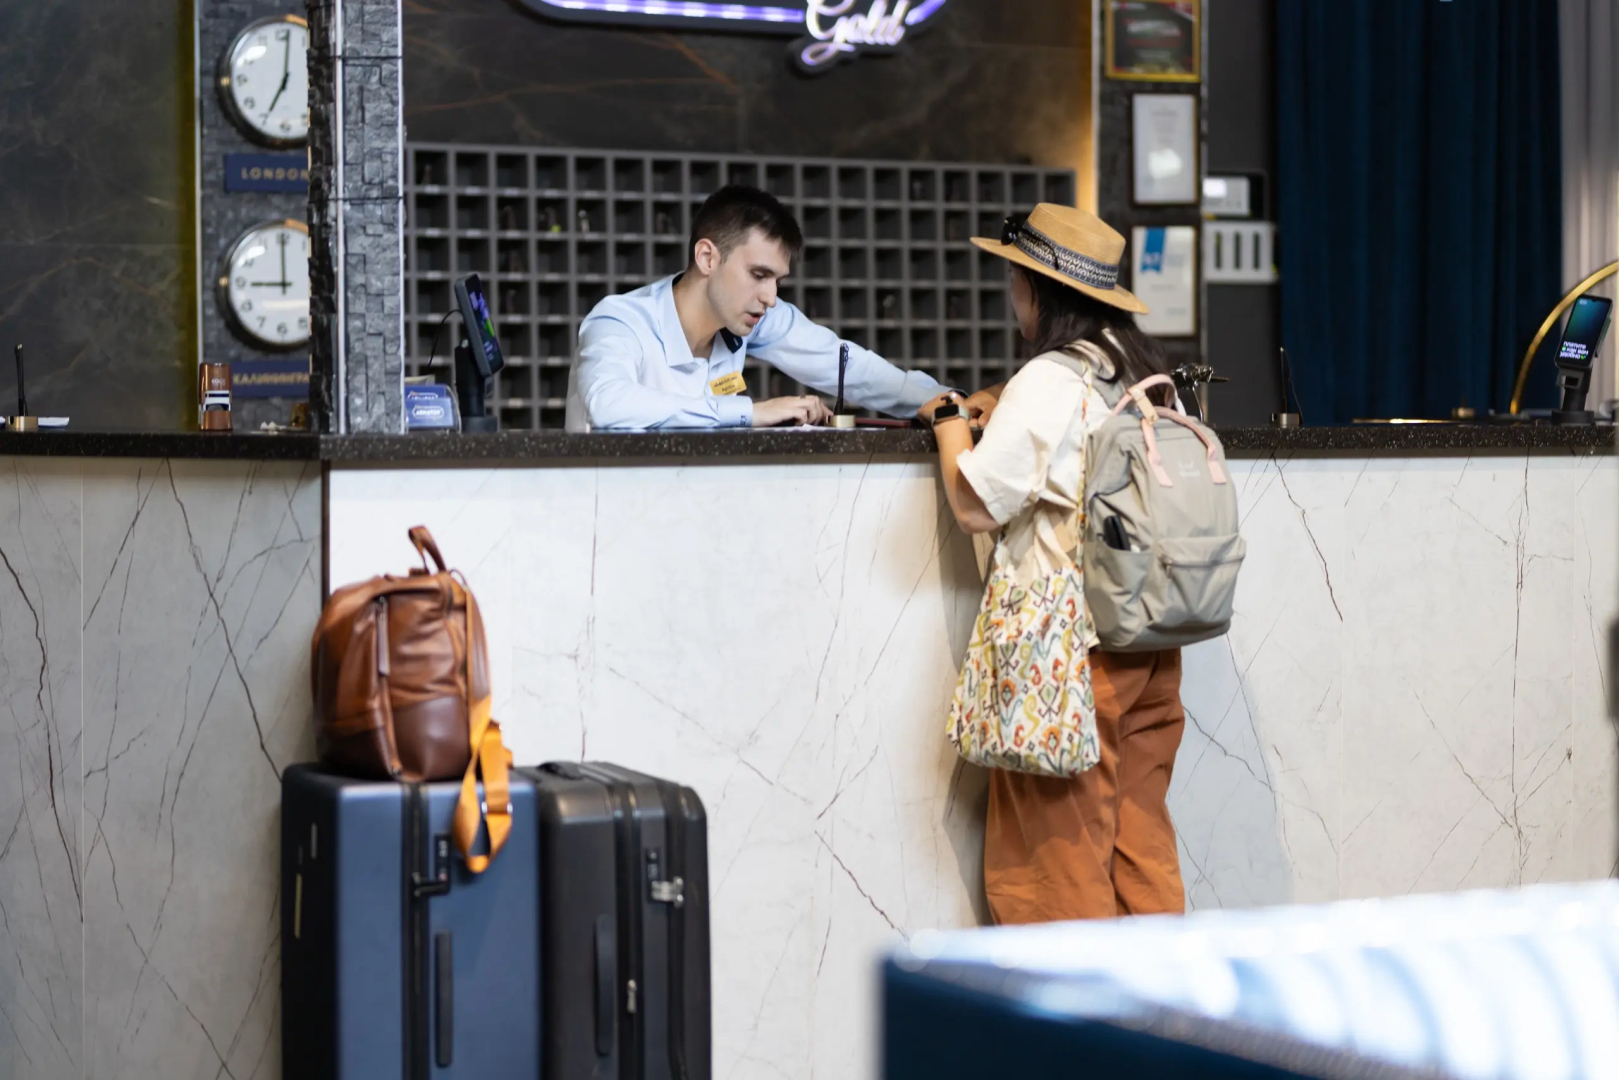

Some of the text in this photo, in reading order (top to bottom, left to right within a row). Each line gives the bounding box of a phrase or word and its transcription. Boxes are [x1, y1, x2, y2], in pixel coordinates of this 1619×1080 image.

[801, 0, 907, 65] Gold
[259, 113, 268, 125] 7
[241, 167, 309, 181] LONDON
[257, 316, 266, 328] 7
[277, 322, 288, 335] 6
